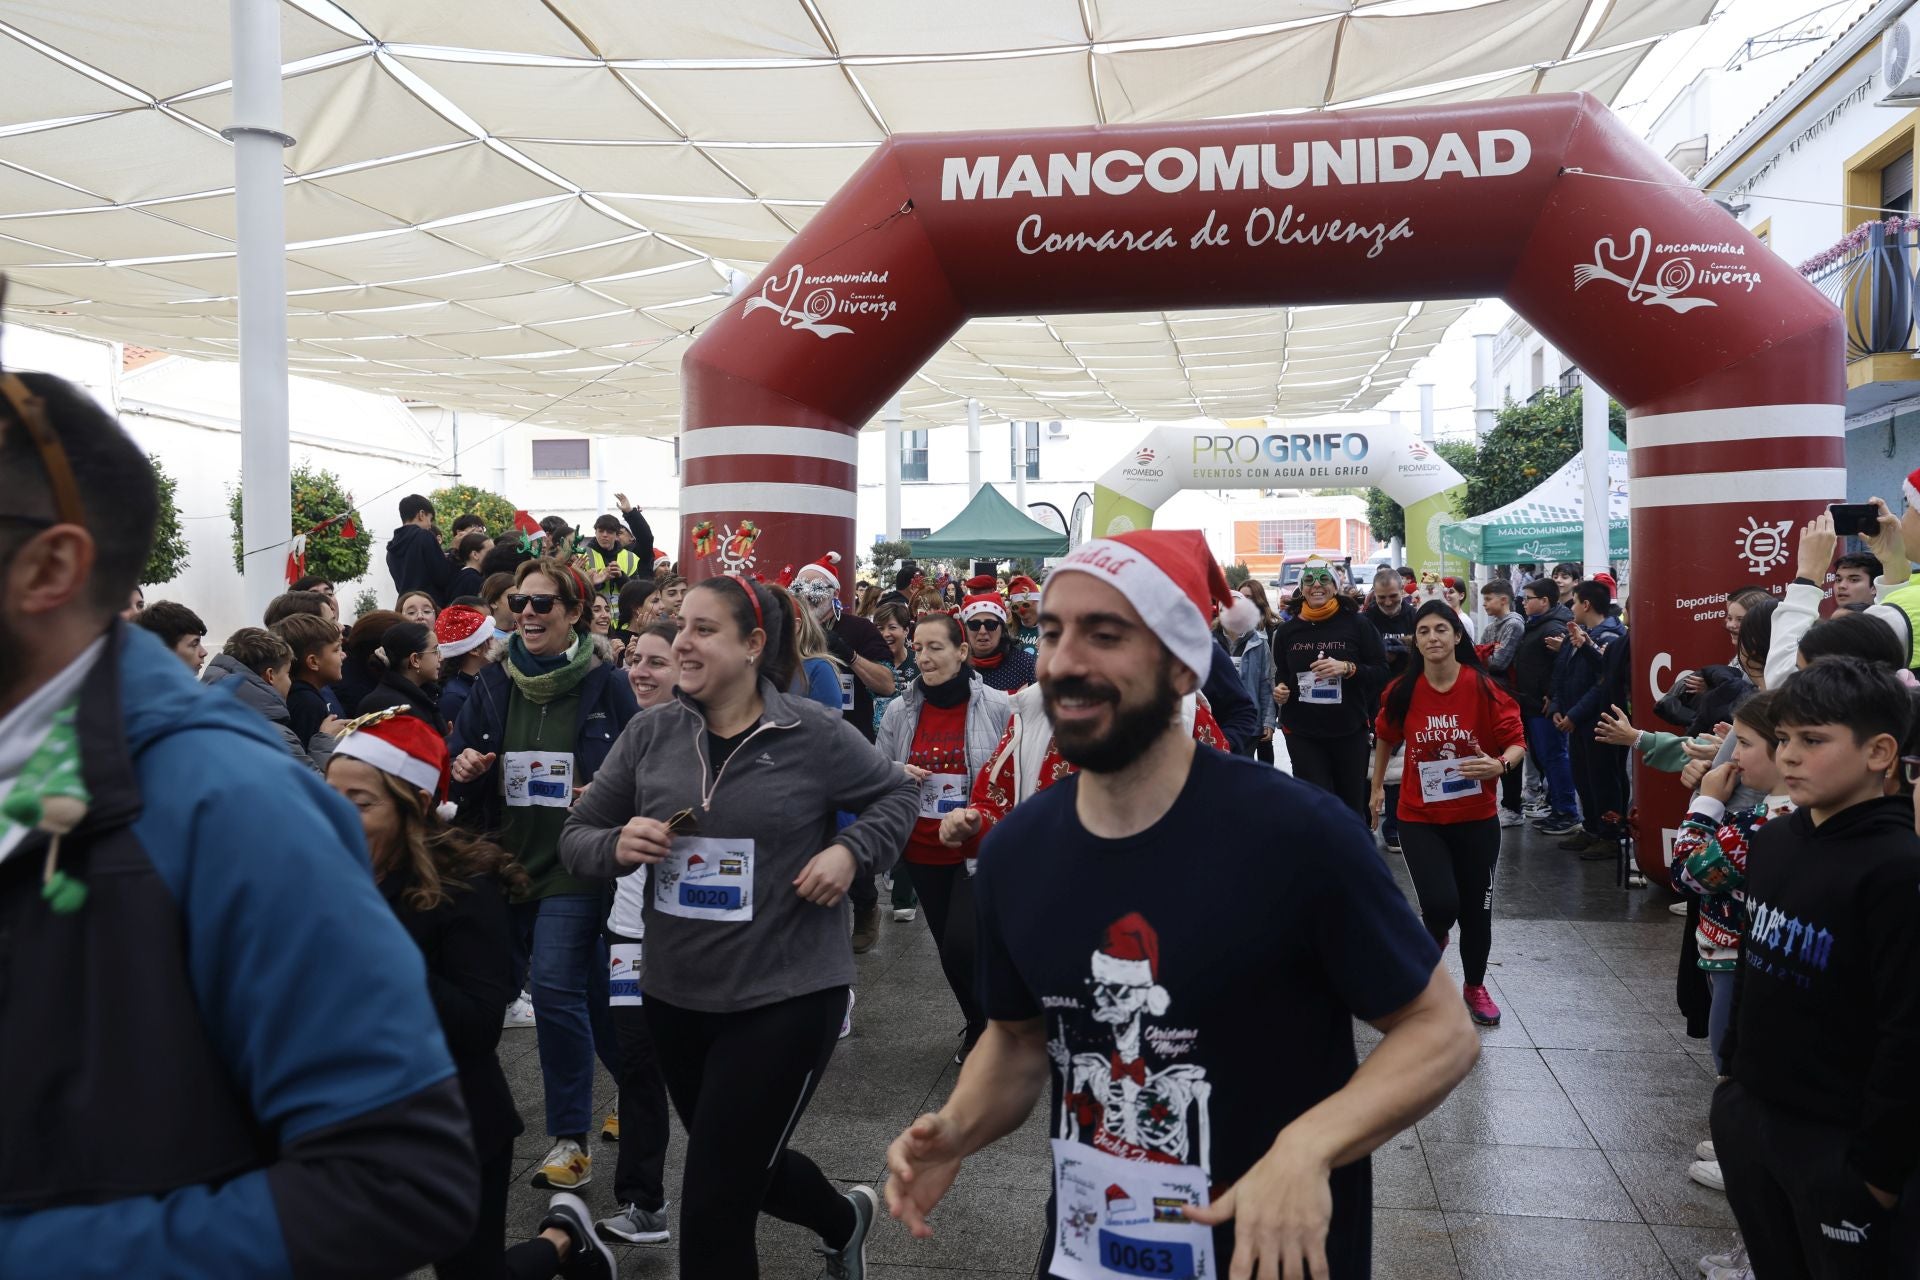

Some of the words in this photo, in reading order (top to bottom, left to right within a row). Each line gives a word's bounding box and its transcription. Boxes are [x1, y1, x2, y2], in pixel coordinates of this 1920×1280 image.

[941, 129, 1532, 201] MANCOMUNIDAD
[1016, 214, 1178, 255] Comarca
[1190, 209, 1229, 249] de
[1244, 204, 1415, 260] Olivenza
[1122, 468, 1164, 477] PROMEDIO
[1193, 469, 1242, 478] EVENTOS
[1247, 469, 1270, 478] CON
[1274, 468, 1305, 477] AGUA
[1310, 467, 1330, 476] DEL
[1334, 466, 1369, 476] GRIFO
[1398, 464, 1441, 472] PROMEDIO
[1498, 525, 1584, 536] MANCOMUNIDAD
[1694, 609, 1726, 622] entre
[1289, 642, 1314, 651] JOHN
[1316, 641, 1346, 650] SMITH
[1425, 714, 1460, 731] JINGLE
[1415, 729, 1449, 743] EVERY
[1450, 729, 1474, 741] DAY
[533, 783, 557, 795] 0007
[686, 889, 729, 905] 0020
[1483, 890, 1492, 910] NIKE
[611, 982, 639, 994] 0078
[1820, 1222, 1861, 1243] PUMA
[1109, 1241, 1174, 1273] 0063
